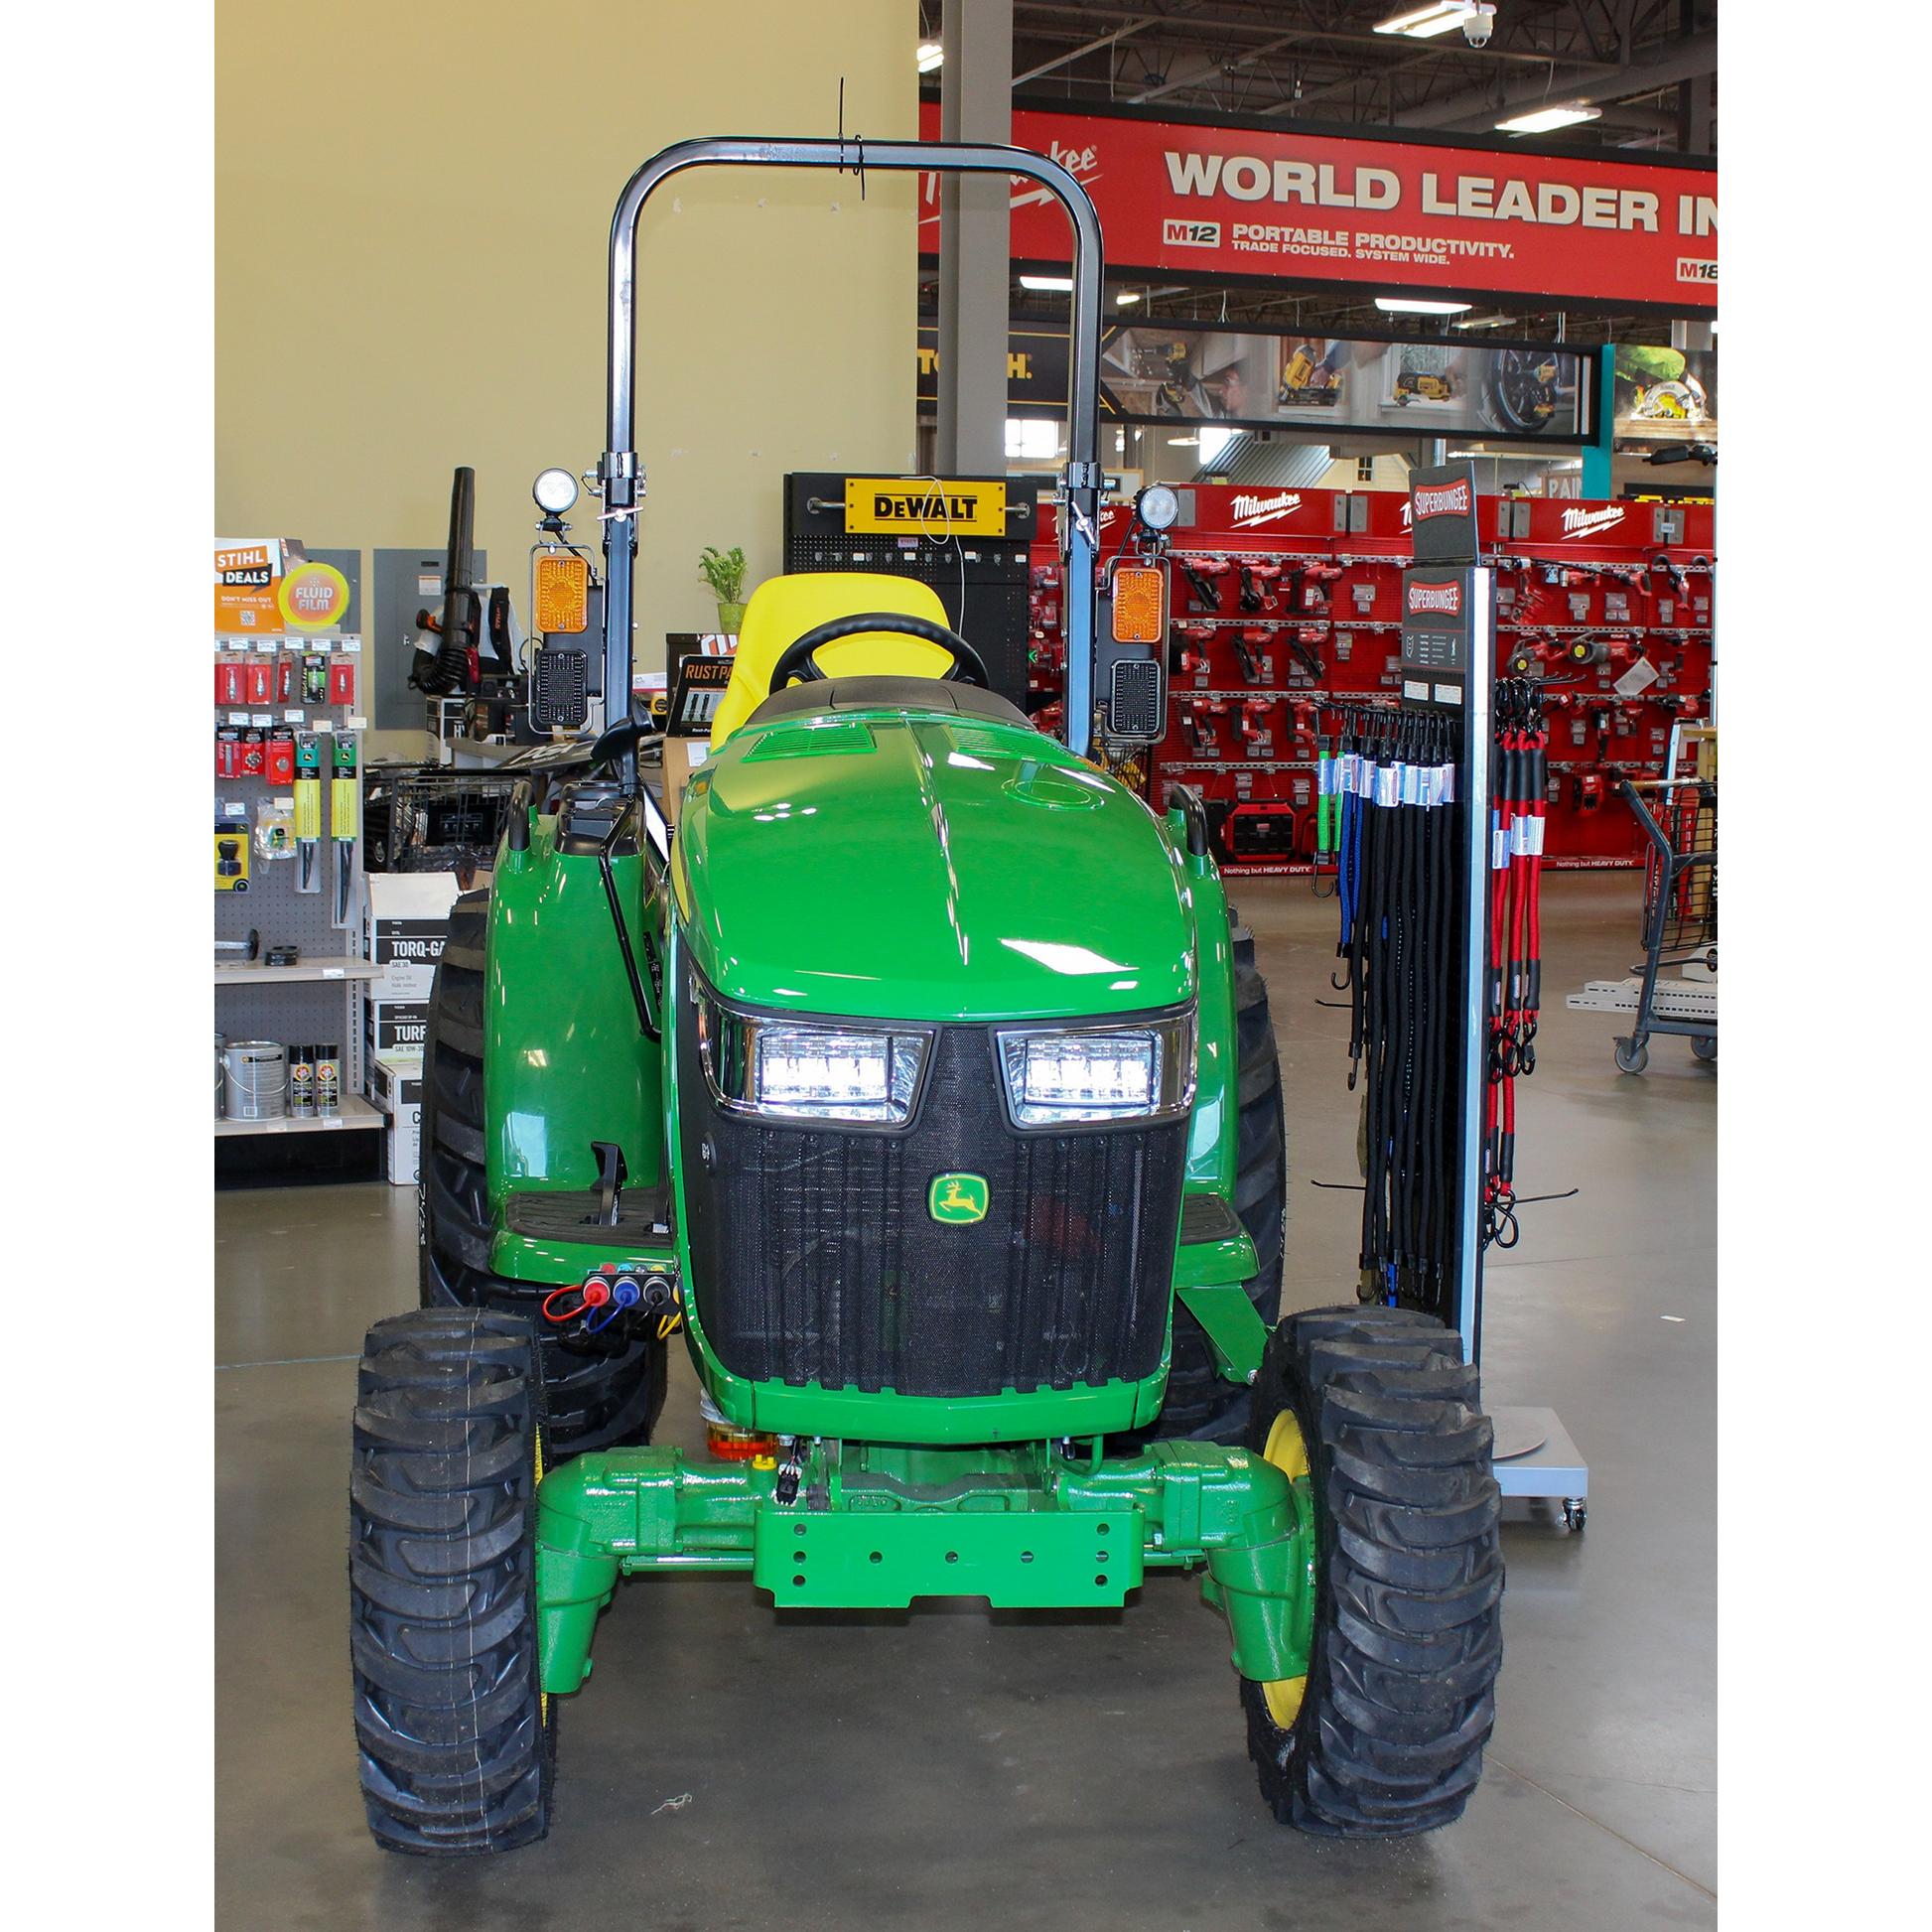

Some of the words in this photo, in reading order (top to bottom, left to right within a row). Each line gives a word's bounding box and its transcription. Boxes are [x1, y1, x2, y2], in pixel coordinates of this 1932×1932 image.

[1165, 151, 1401, 210] WORLD
[1422, 172, 1659, 232] LEADER
[1167, 224, 1218, 243] M12
[1232, 223, 1349, 246] PORTABLE
[1355, 232, 1515, 259] PRODUCTIVITY.
[1232, 240, 1279, 253] TRADE
[1283, 244, 1352, 258] FOCUSED.
[1356, 249, 1410, 262] SYSTEM
[1414, 253, 1450, 265] WIDE.
[1230, 491, 1302, 521] Milwaukee
[1415, 484, 1467, 516] SUPERBUNGEE
[1561, 505, 1624, 532] Milwaukee
[217, 550, 265, 568] STIHL
[225, 571, 269, 584] DEALS
[295, 587, 334, 599] FLUID
[298, 599, 330, 611] FILM
[1408, 587, 1458, 611] SUPERBUNGEE
[686, 664, 719, 679] RUST
